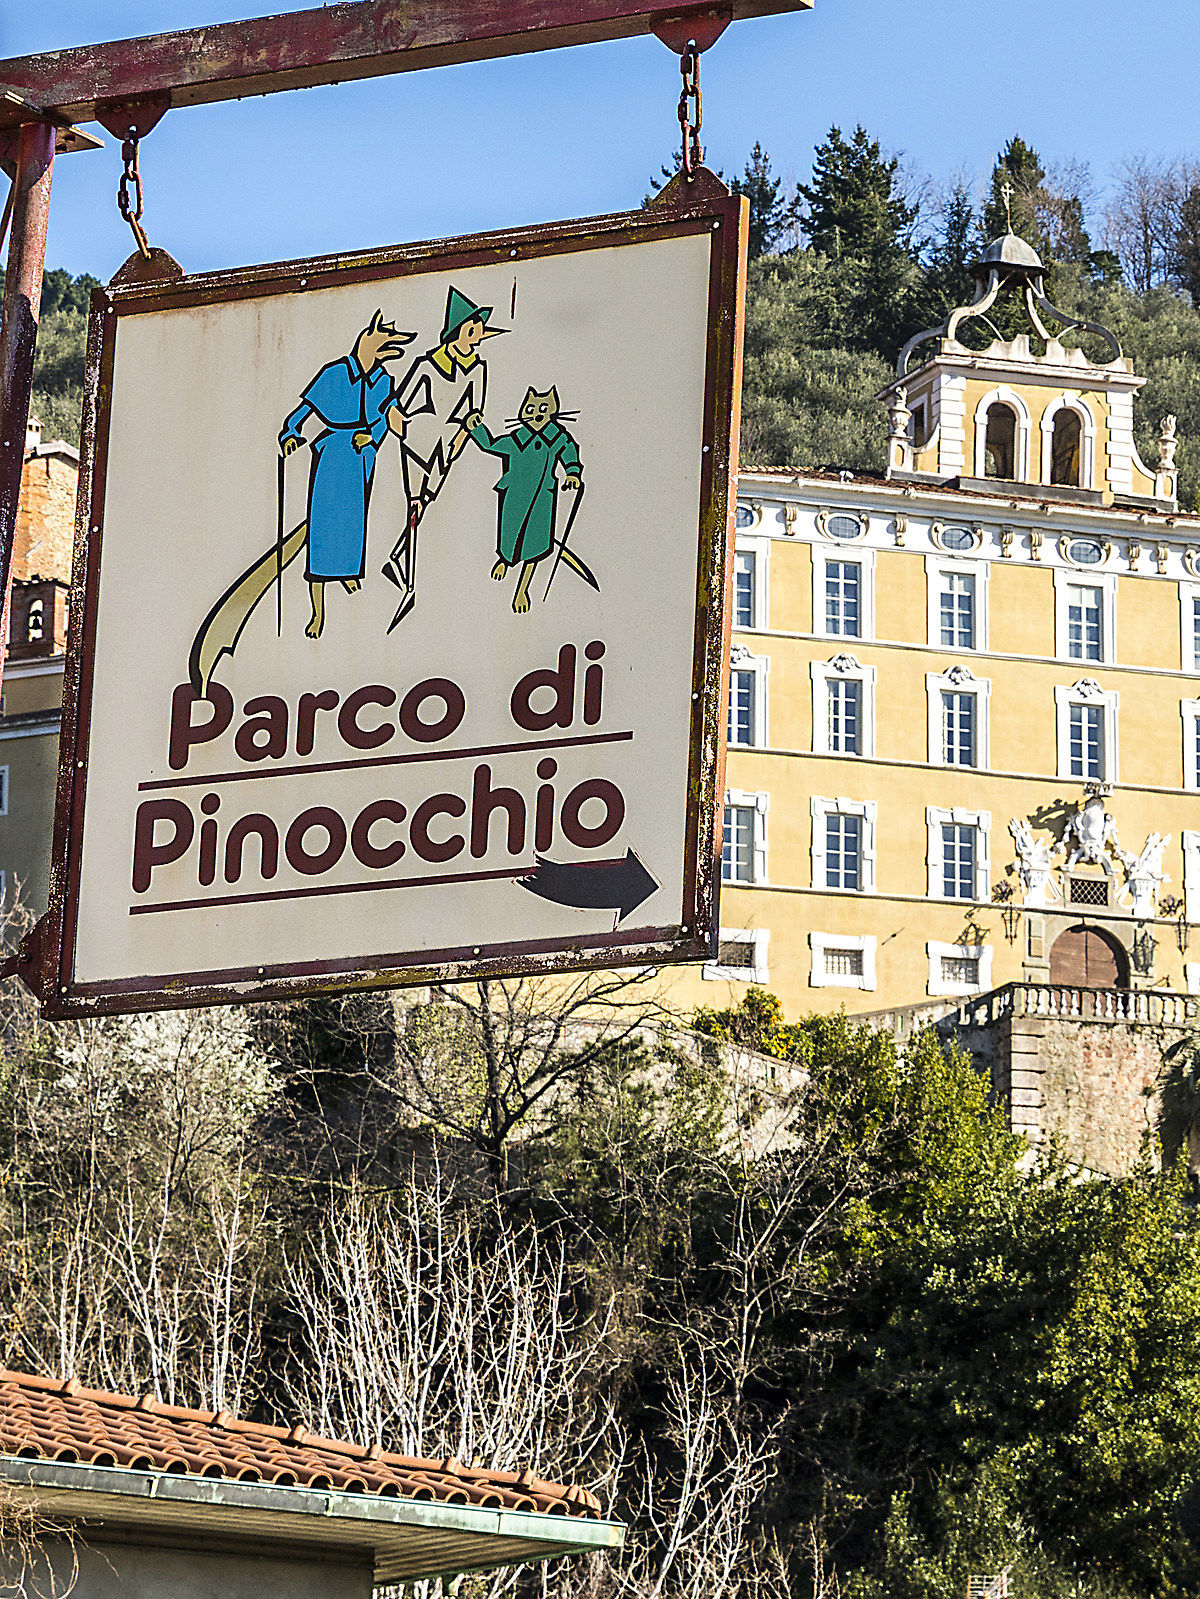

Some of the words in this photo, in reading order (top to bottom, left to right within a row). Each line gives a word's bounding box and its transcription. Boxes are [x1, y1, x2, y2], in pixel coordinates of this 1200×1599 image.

[168, 677, 466, 771] Parco
[510, 640, 606, 732] di
[131, 757, 626, 894] Pinocchio
